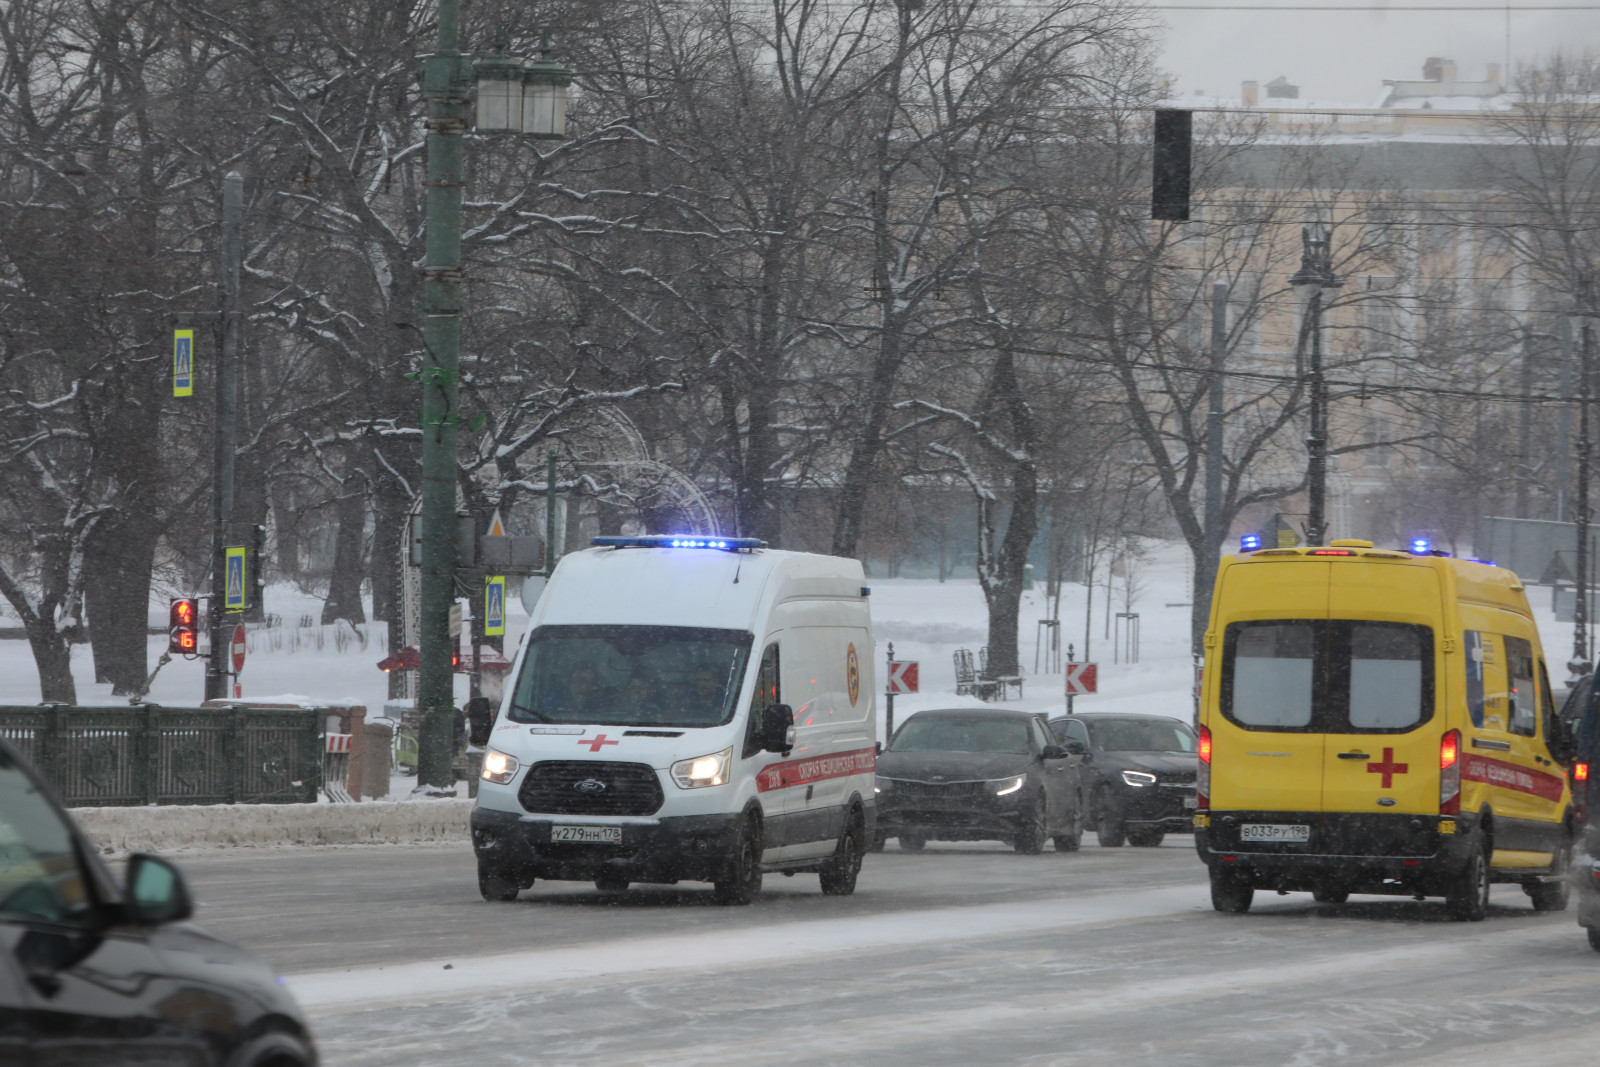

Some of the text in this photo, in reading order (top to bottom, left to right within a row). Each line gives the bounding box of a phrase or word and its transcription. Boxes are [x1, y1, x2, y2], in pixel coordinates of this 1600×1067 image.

[180, 632, 193, 647] 16
[555, 828, 619, 840] У279НН 178
[1243, 825, 1288, 837] В033РУ
